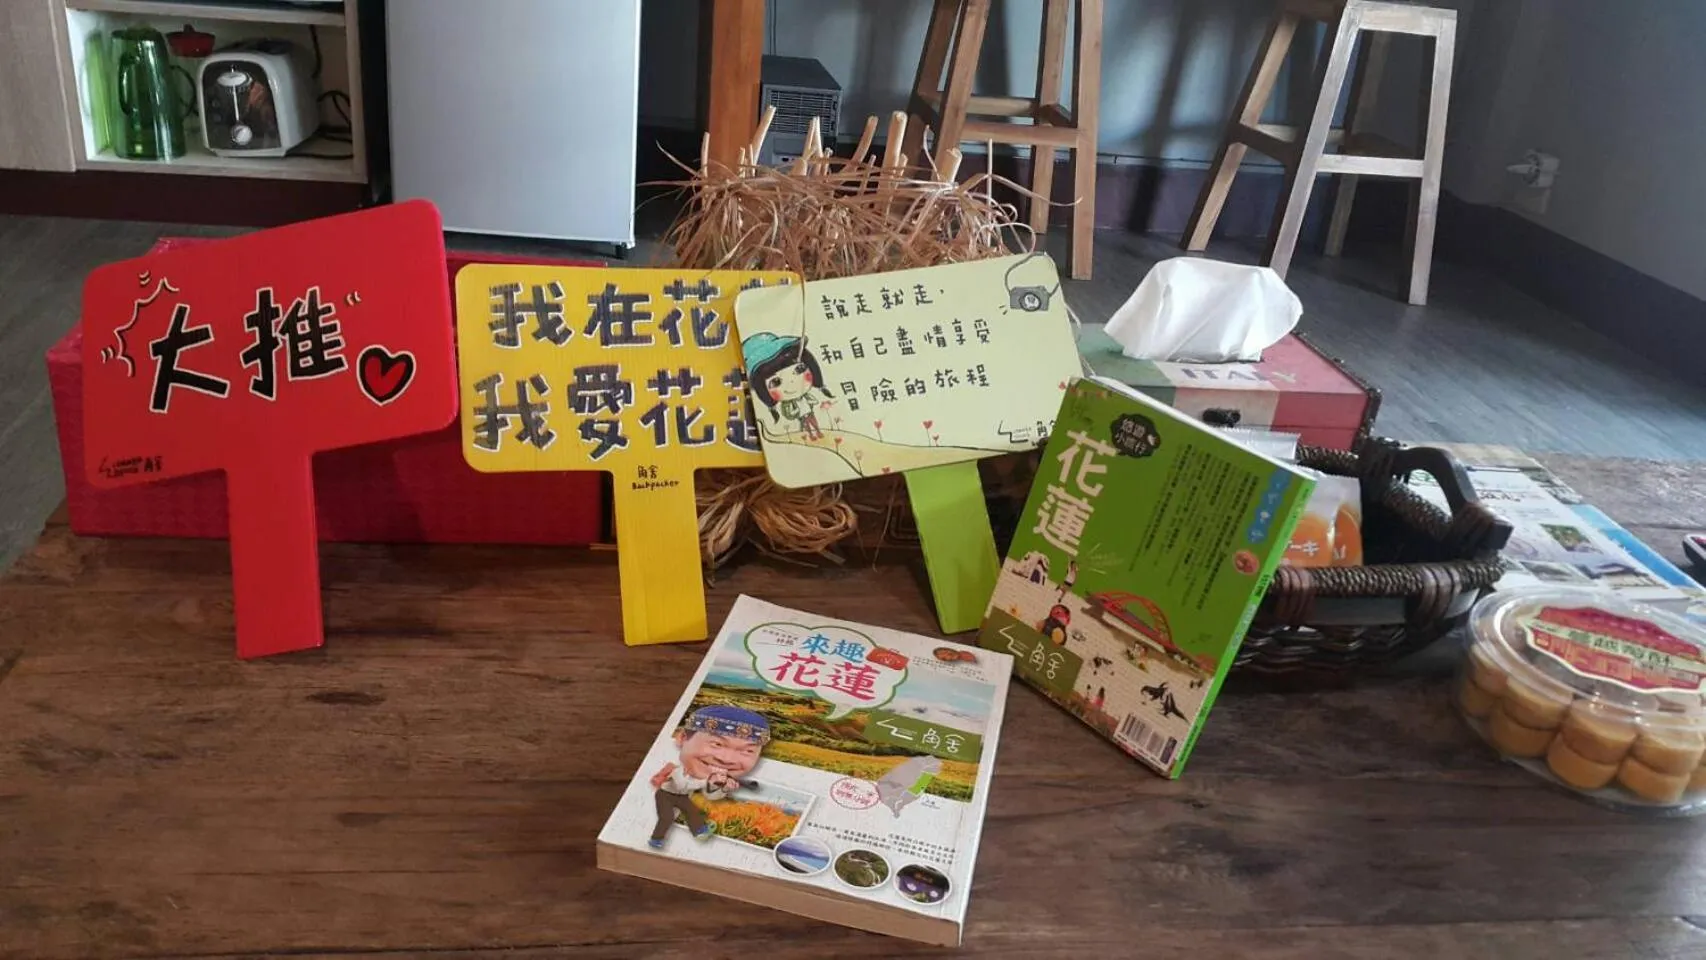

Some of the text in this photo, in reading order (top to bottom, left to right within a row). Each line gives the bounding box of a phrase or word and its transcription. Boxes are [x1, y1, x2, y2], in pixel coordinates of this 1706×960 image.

[488, 277, 792, 349] 我在花
[149, 286, 348, 414] 大推
[821, 317, 991, 364] 和自己盡情享受
[841, 363, 990, 412] 冒險的旅程
[1033, 430, 1117, 557] 花蓮
[799, 633, 866, 664] 來趣
[768, 652, 881, 702] 花蓮
[921, 727, 966, 754] 角舍
